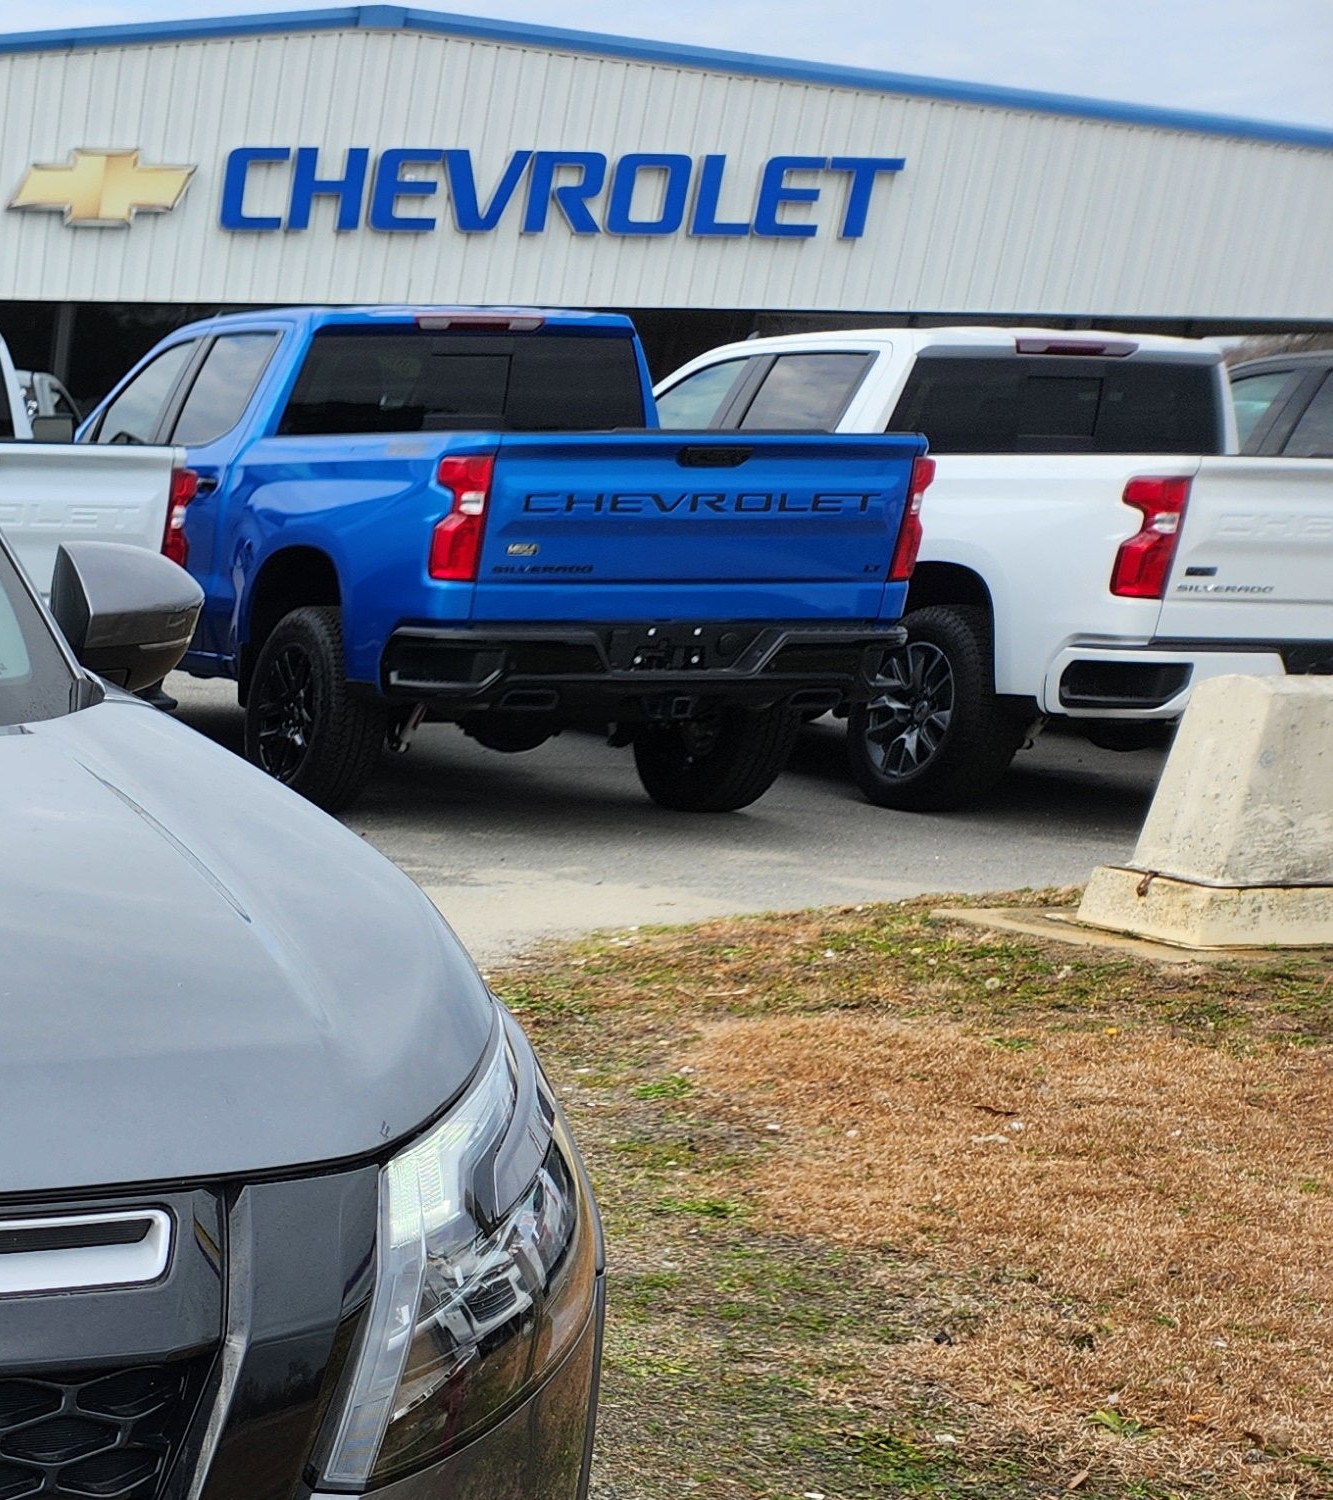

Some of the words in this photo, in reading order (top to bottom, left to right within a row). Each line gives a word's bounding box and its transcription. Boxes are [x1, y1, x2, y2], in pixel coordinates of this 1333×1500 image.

[219, 146, 906, 239] CHEVROLET
[521, 491, 883, 514] CHEVROLET
[491, 563, 595, 575] SILVERADO
[1176, 583, 1275, 594] SILVERADO
